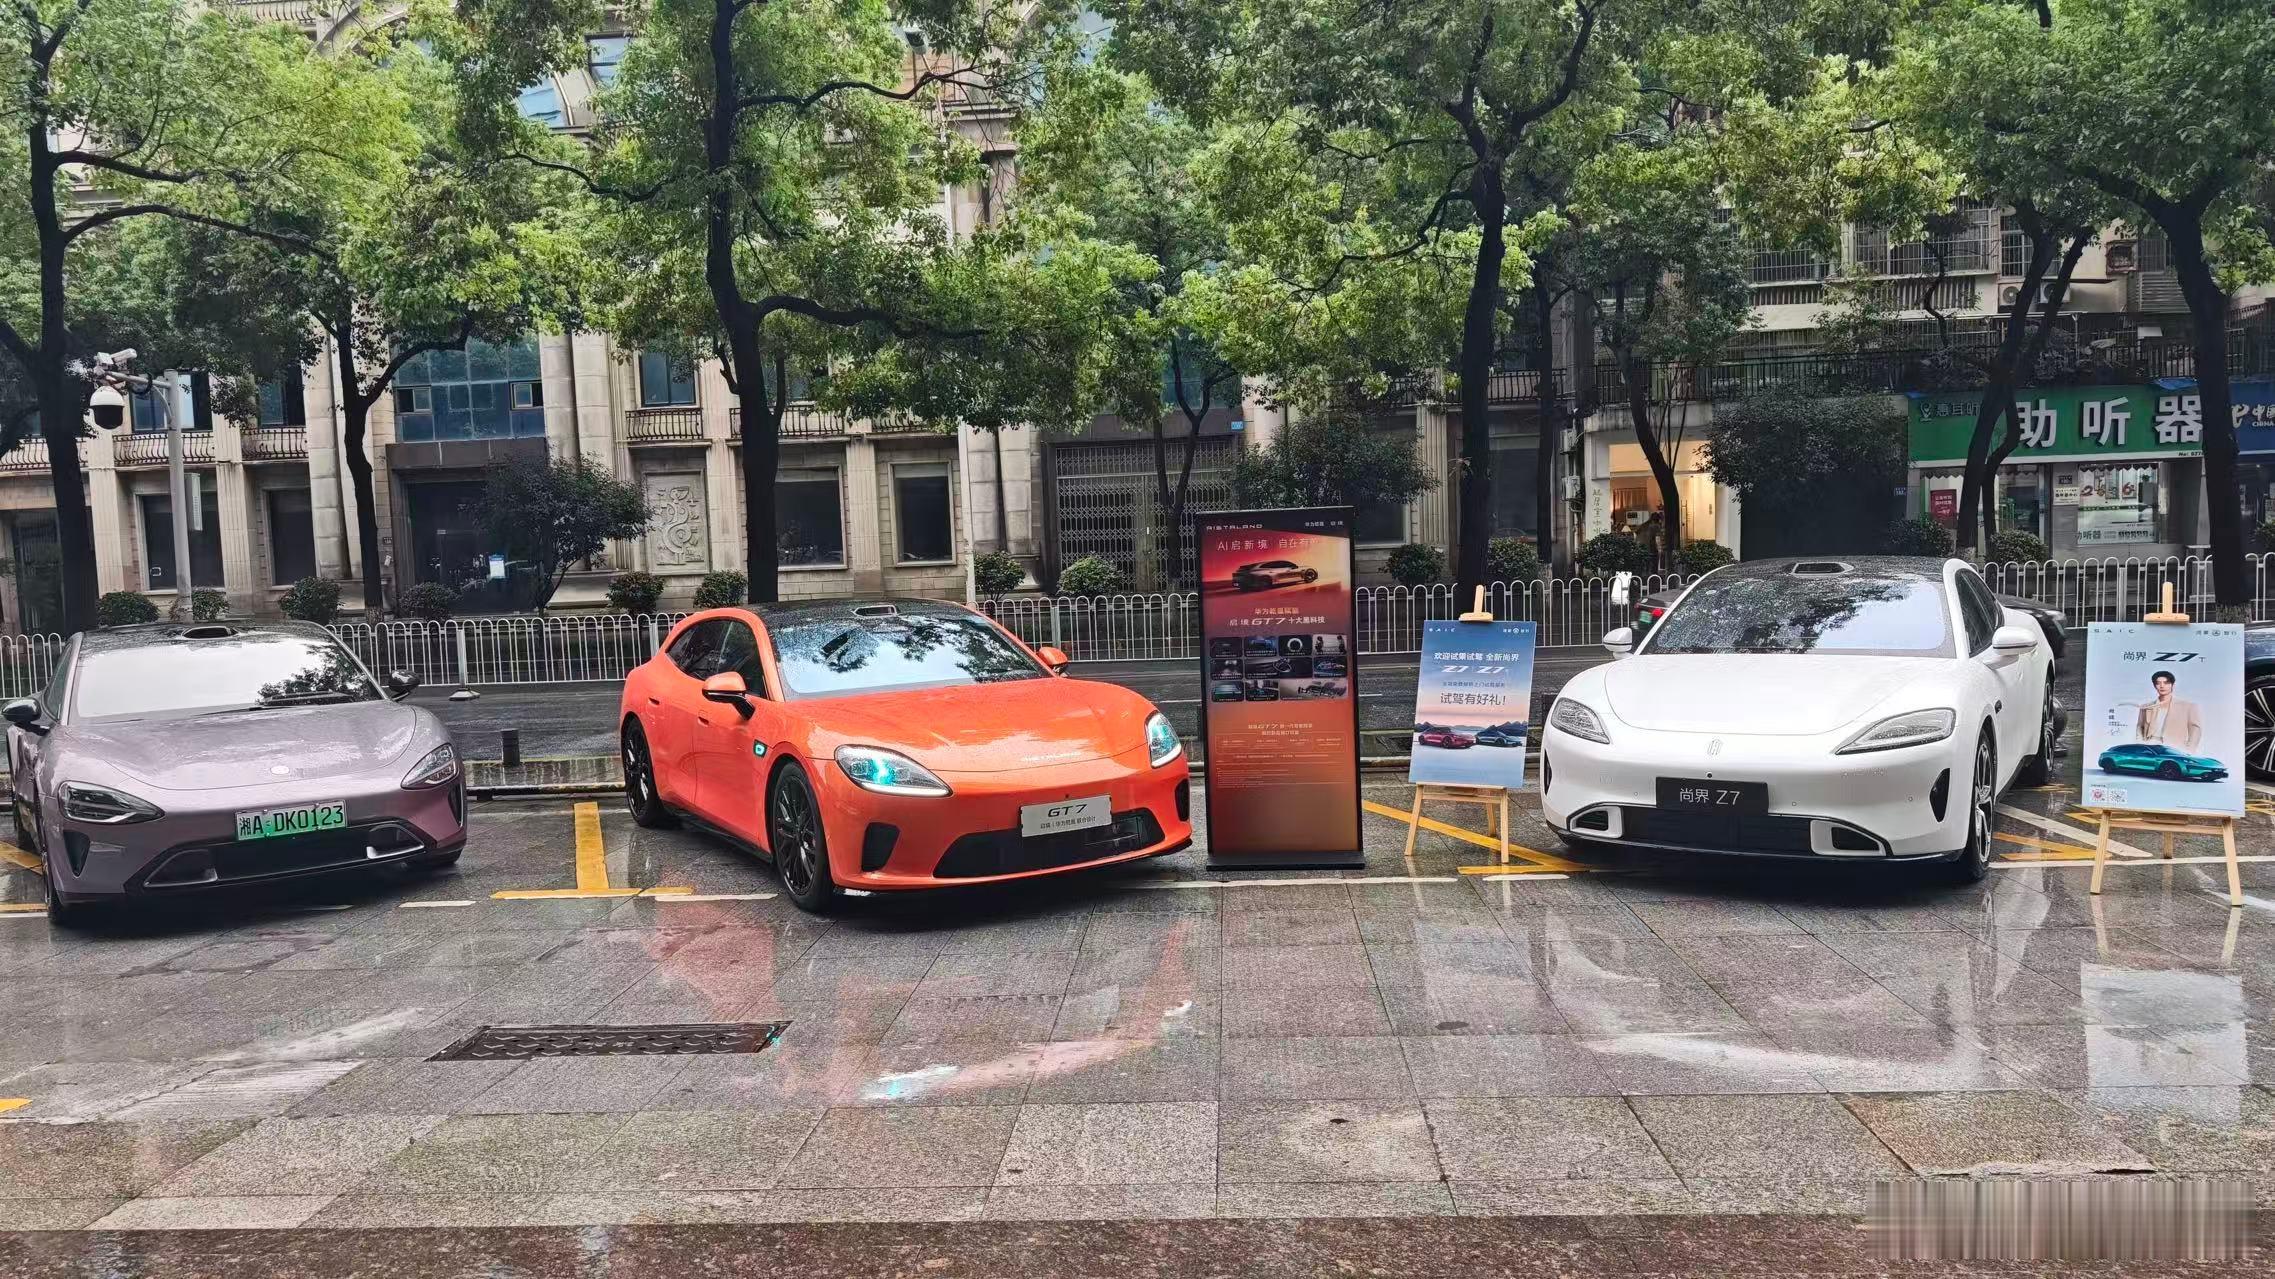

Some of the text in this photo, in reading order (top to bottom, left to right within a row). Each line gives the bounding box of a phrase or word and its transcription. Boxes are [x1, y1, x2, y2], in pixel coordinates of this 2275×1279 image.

[2019, 394, 2203, 448] 助听器
[2123, 651, 2147, 661] 尚界
[1680, 788, 1740, 806] 尚界 Z7
